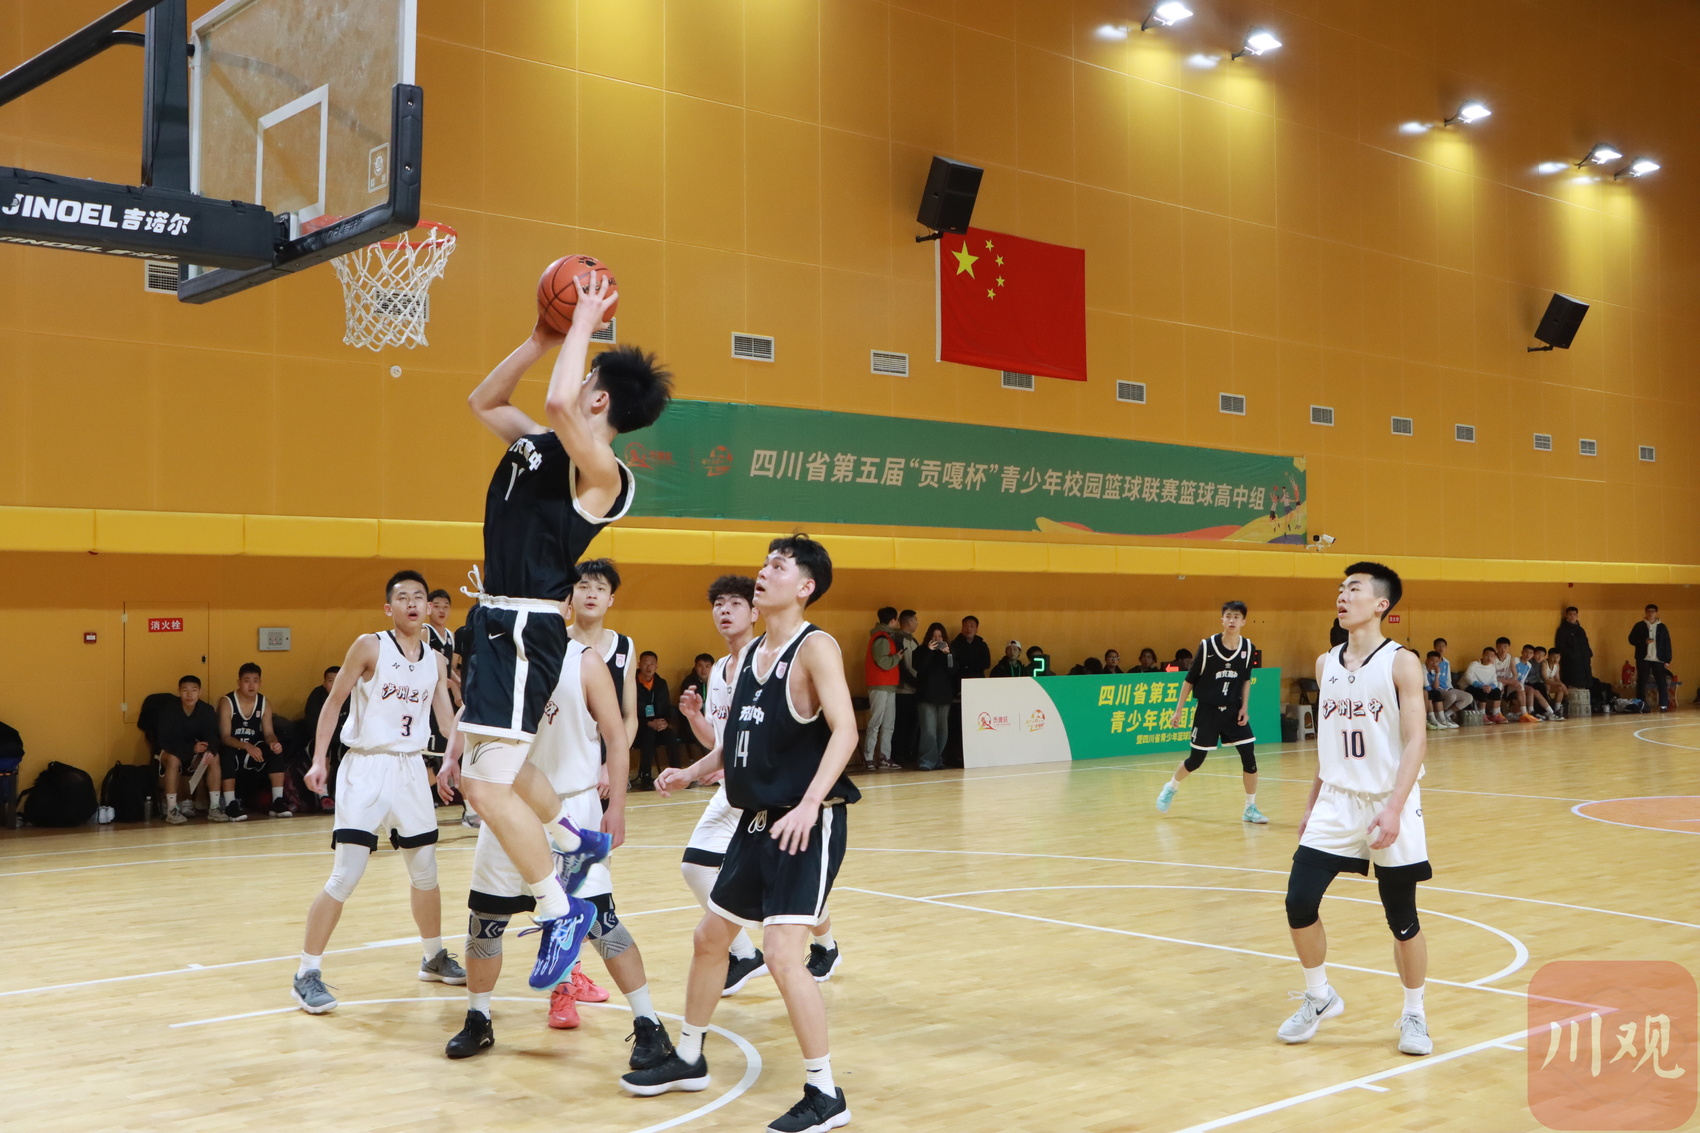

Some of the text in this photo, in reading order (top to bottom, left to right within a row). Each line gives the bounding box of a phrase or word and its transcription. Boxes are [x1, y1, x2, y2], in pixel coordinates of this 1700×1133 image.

[2, 193, 191, 236] JINOEL 吉诺尔
[750, 449, 1266, 511] 四川省第五届“贡嘎杯”青少年校园篮球联赛篮球高中组
[150, 620, 182, 631] 消火栓
[1222, 681, 1231, 696] 4
[1322, 698, 1384, 722] 泸州二中
[401, 715, 413, 737] 3
[733, 730, 750, 768] 14
[1340, 729, 1366, 760] 10
